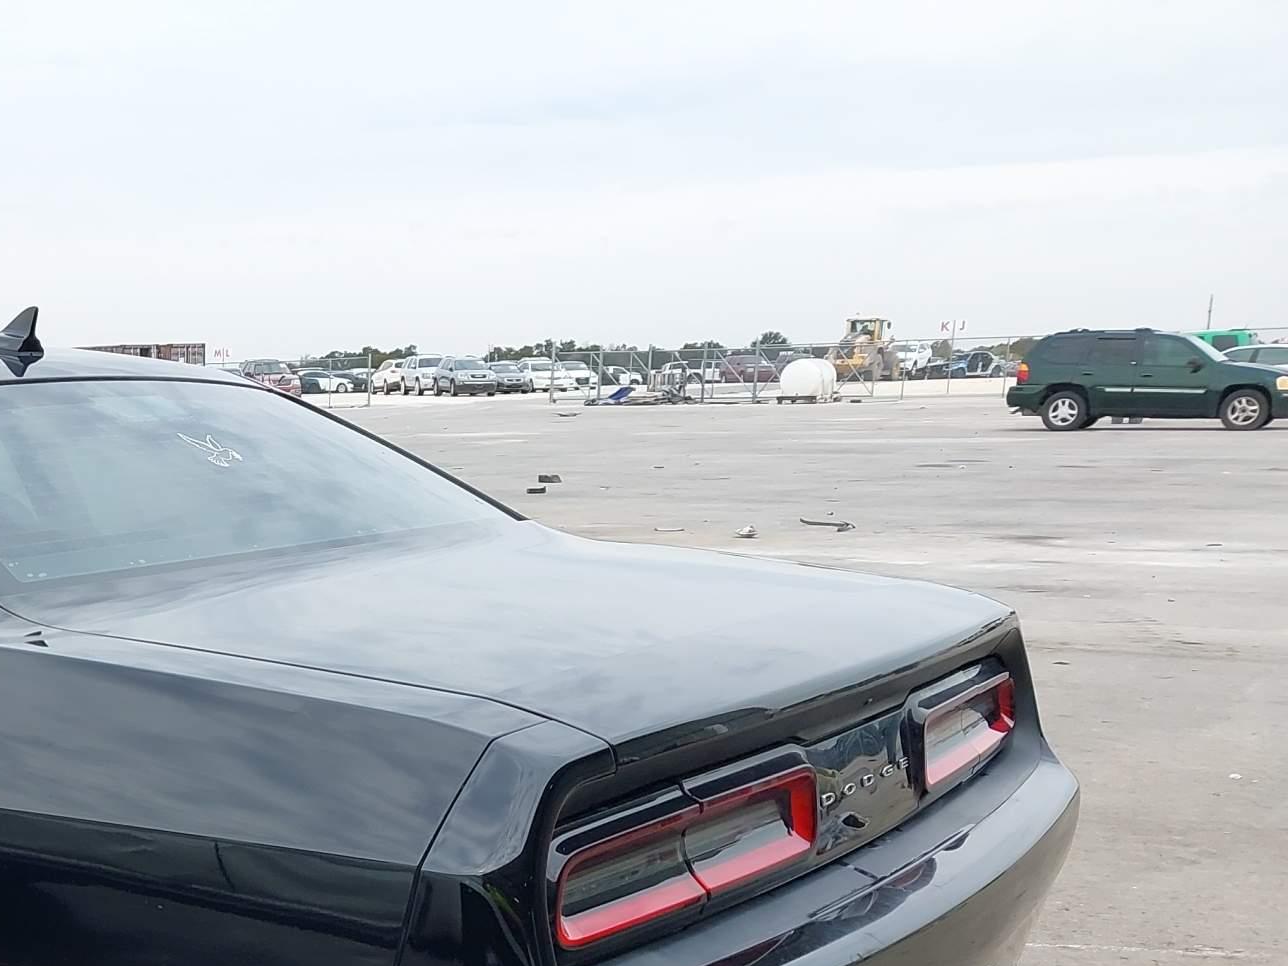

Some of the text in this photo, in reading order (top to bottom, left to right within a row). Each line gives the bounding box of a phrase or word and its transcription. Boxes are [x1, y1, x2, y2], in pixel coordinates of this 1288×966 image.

[941, 321, 950, 332] K
[959, 320, 966, 331] J
[214, 349, 222, 358] M
[225, 349, 231, 358] L
[821, 756, 909, 807] DODGE
